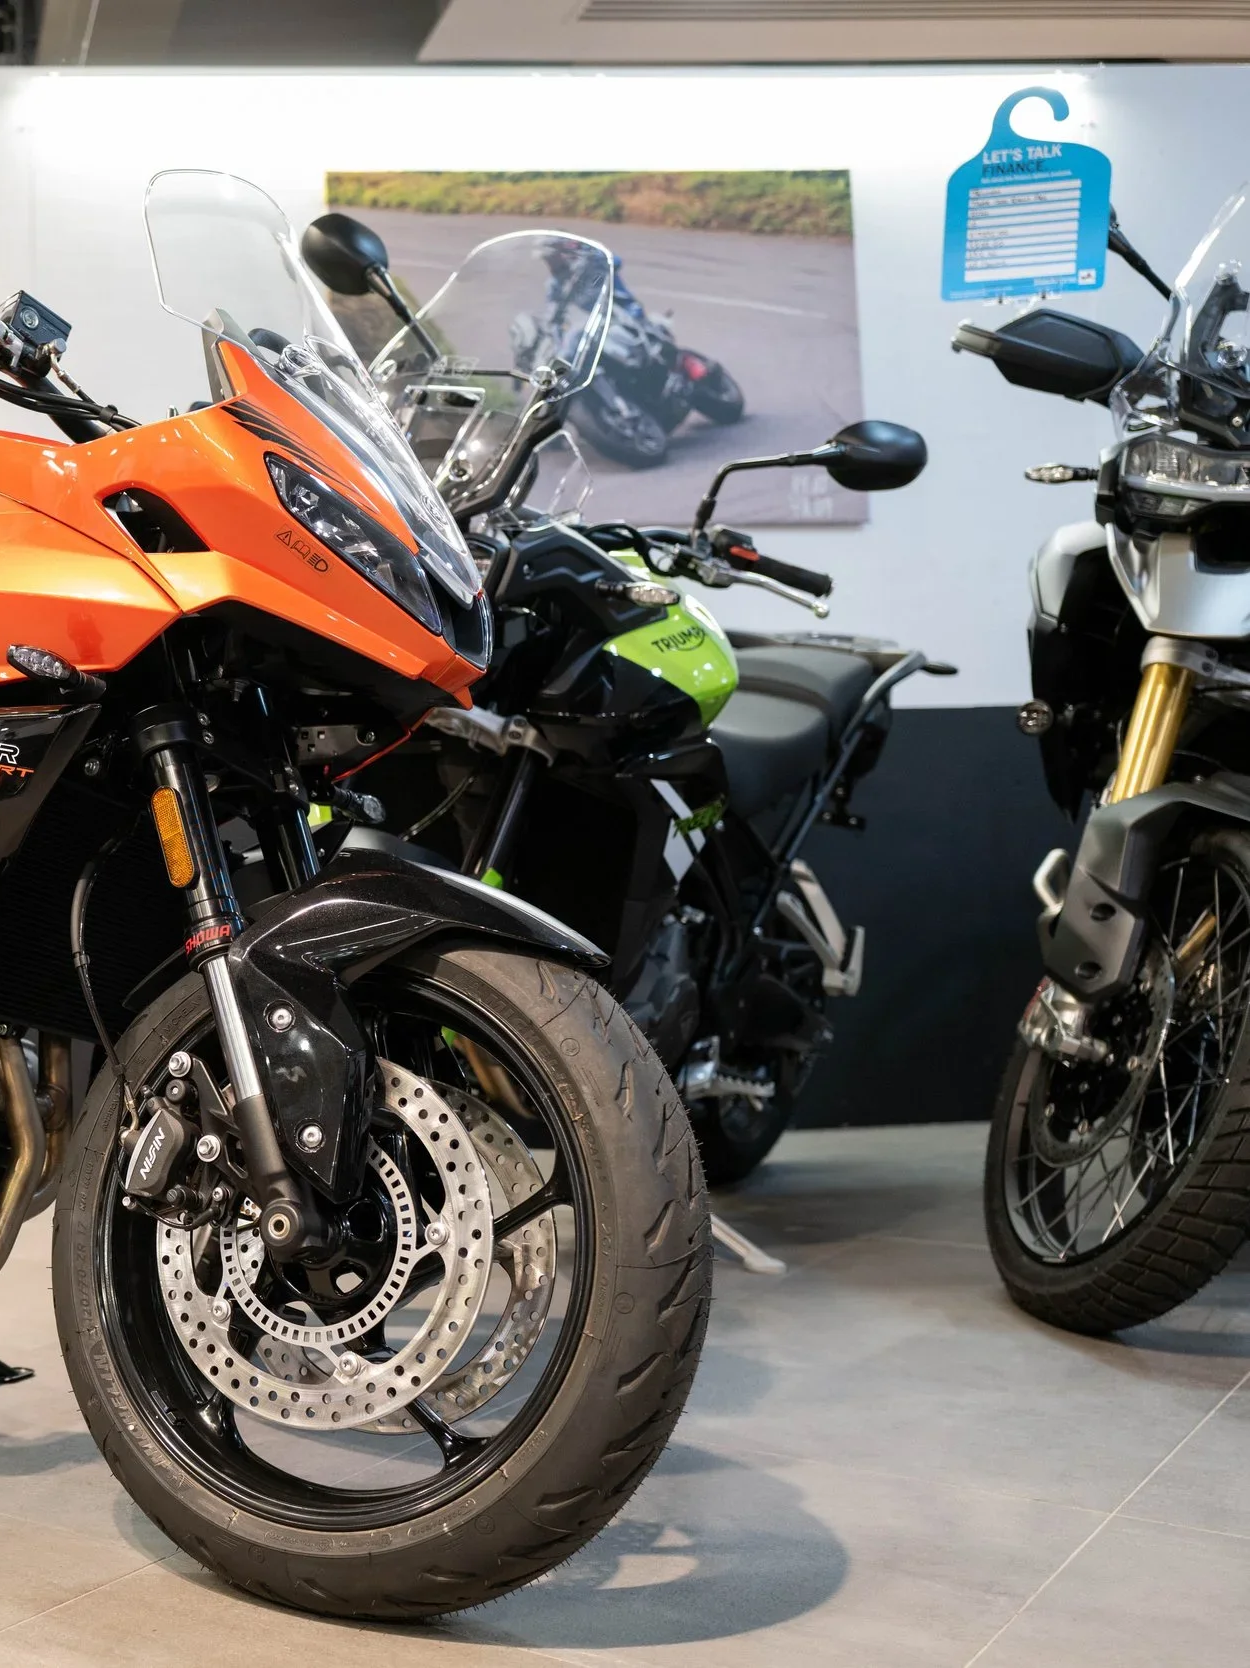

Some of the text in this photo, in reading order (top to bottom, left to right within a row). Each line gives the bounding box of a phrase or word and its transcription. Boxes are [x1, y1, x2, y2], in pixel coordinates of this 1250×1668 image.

[982, 159, 1044, 176] FINANCE
[983, 143, 1062, 164] LET'S TALK
[185, 925, 230, 956] SHOWA
[139, 1126, 166, 1181] NISSIN
[93, 1352, 166, 1468] MICHELIN
